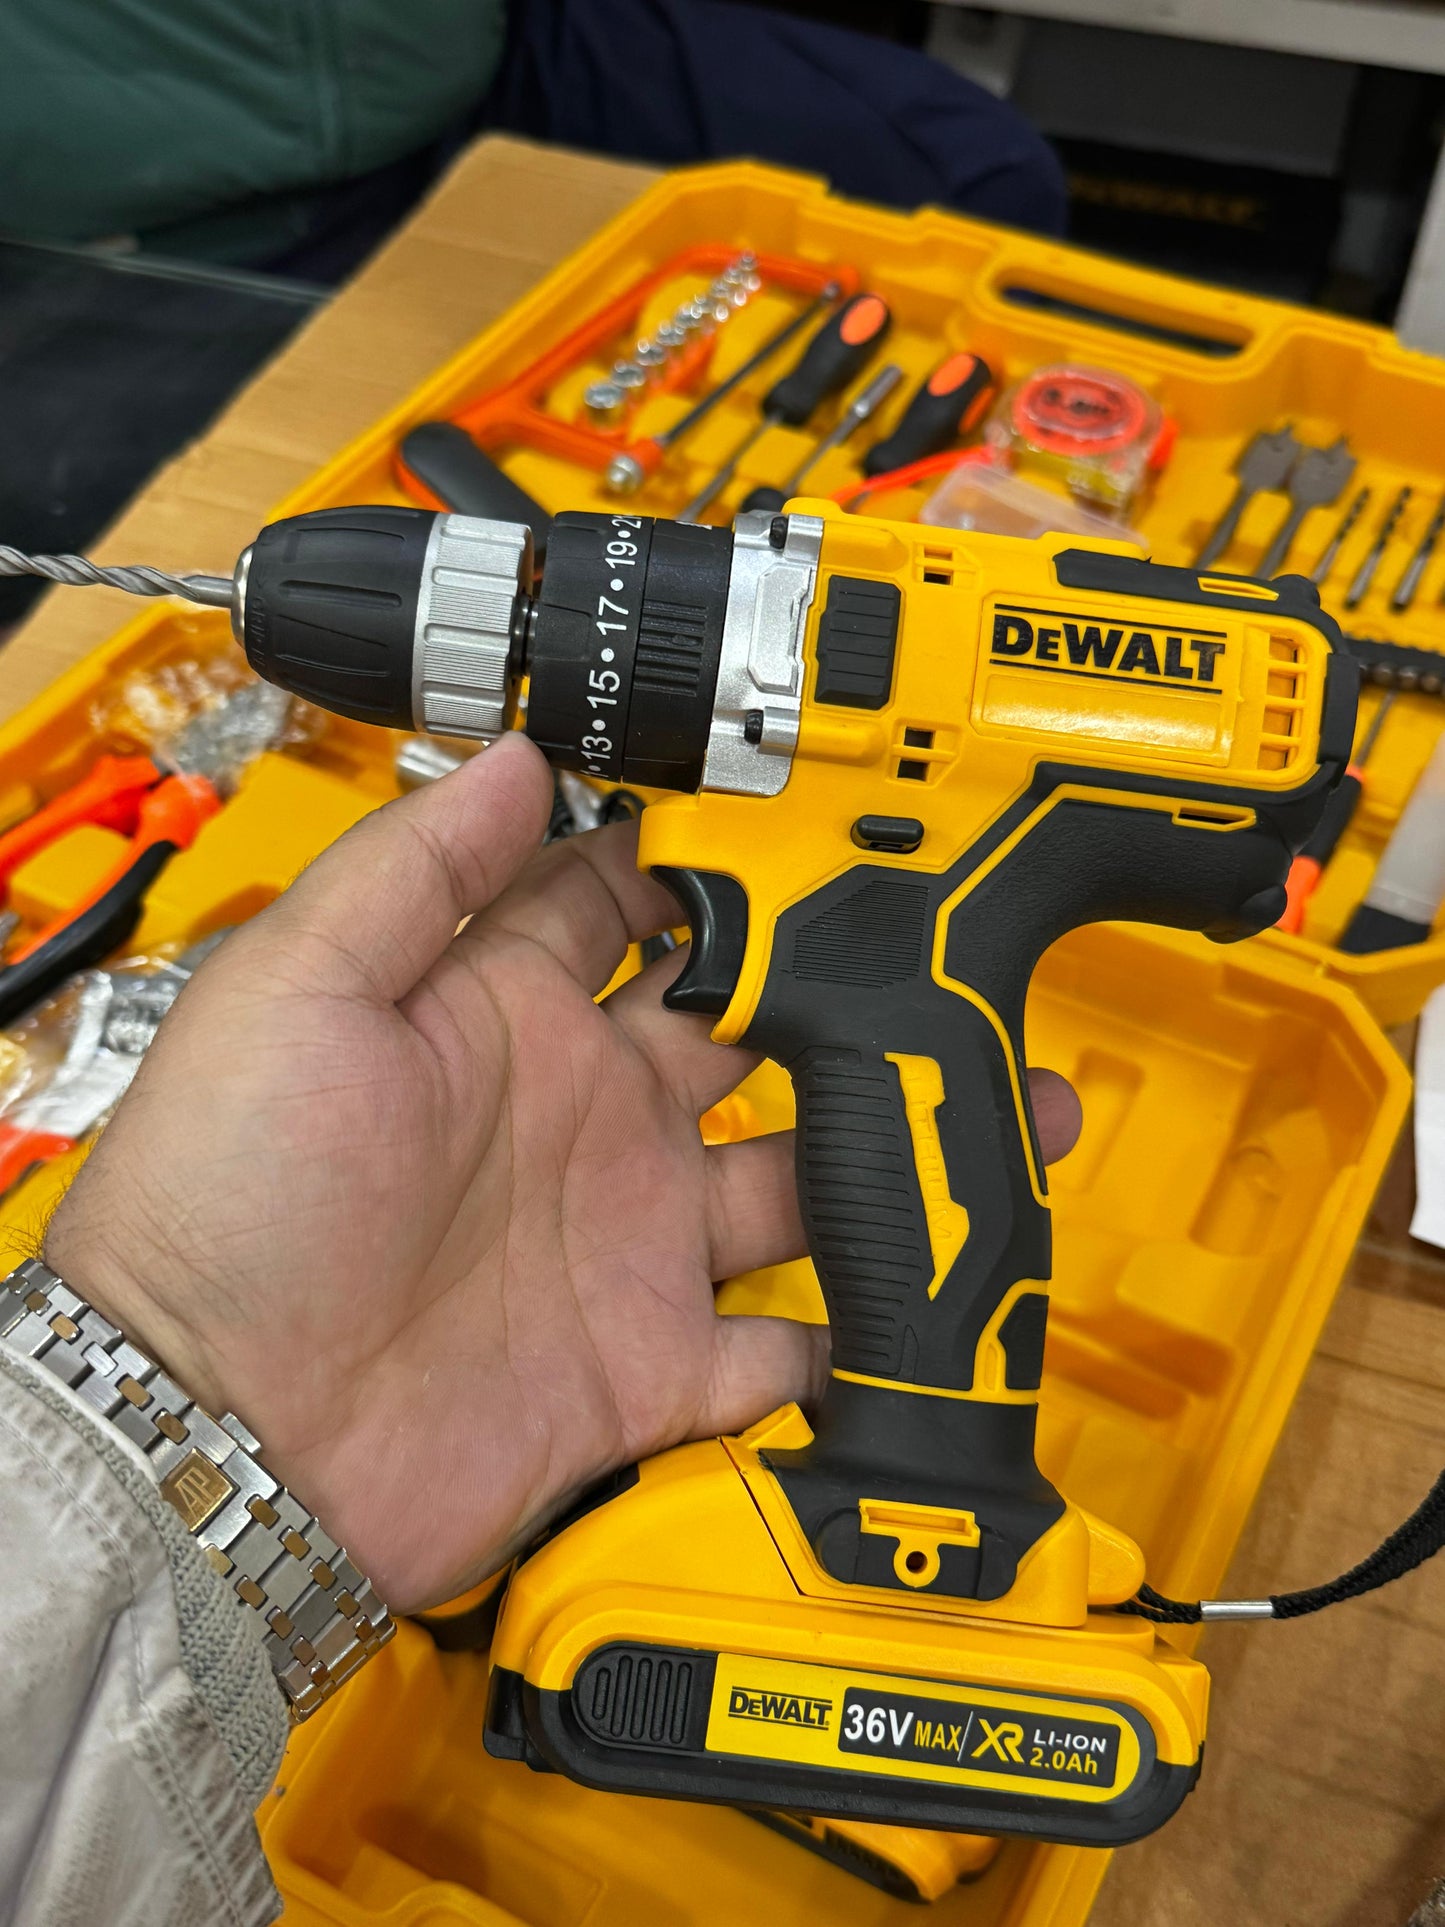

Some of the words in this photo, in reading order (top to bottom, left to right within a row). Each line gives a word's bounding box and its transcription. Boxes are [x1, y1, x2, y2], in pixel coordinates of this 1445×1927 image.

[604, 541, 638, 569] 19
[596, 595, 629, 636] 17
[586, 669, 621, 708] 15
[580, 735, 613, 760] 13
[174, 1466, 221, 1521] AP
[844, 1703, 914, 1747] 36V
[914, 1719, 962, 1751] MAX
[970, 1718, 1025, 1764] XR
[1033, 1728, 1107, 1754] LI-ION
[1029, 1747, 1098, 1775] 2.0Ah
